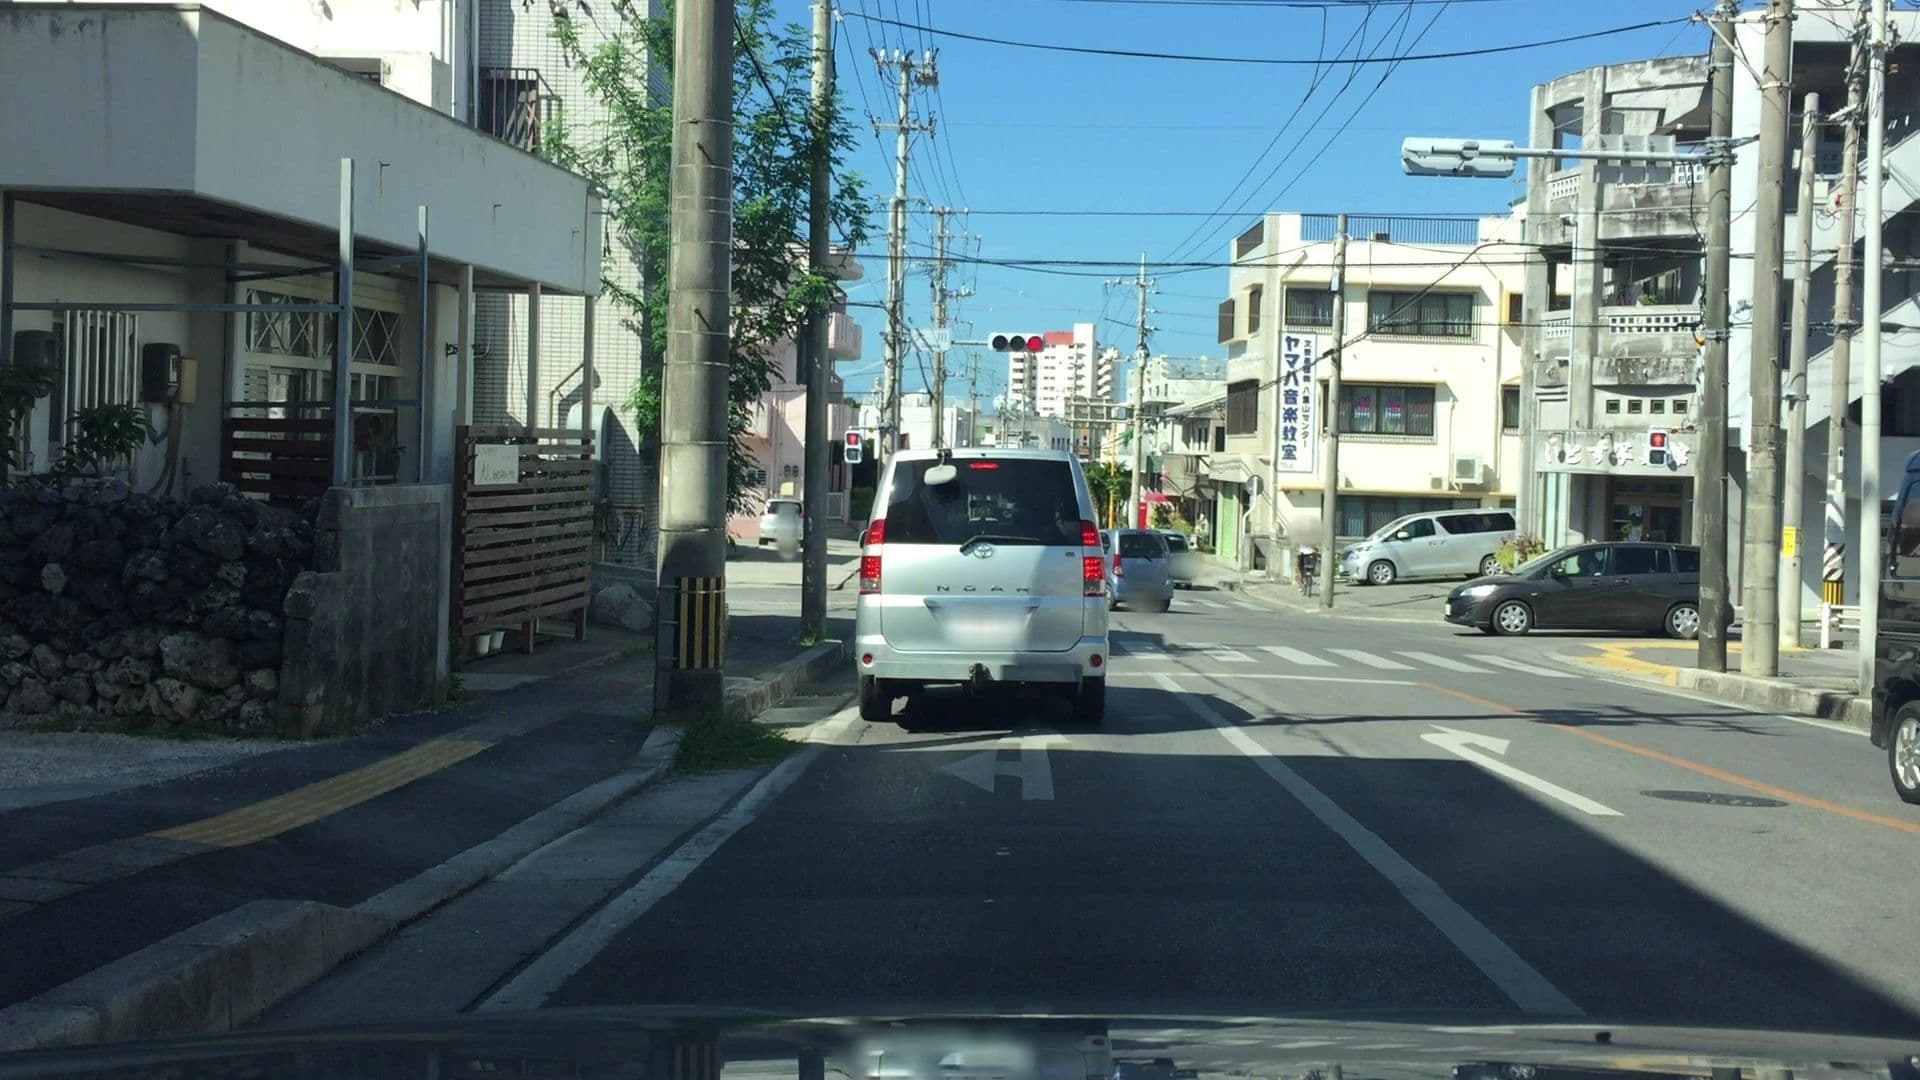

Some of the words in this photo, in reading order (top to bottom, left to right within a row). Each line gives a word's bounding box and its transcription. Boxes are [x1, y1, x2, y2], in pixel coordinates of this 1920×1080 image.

[1282, 336, 1300, 460] ヤマハ音楽教室
